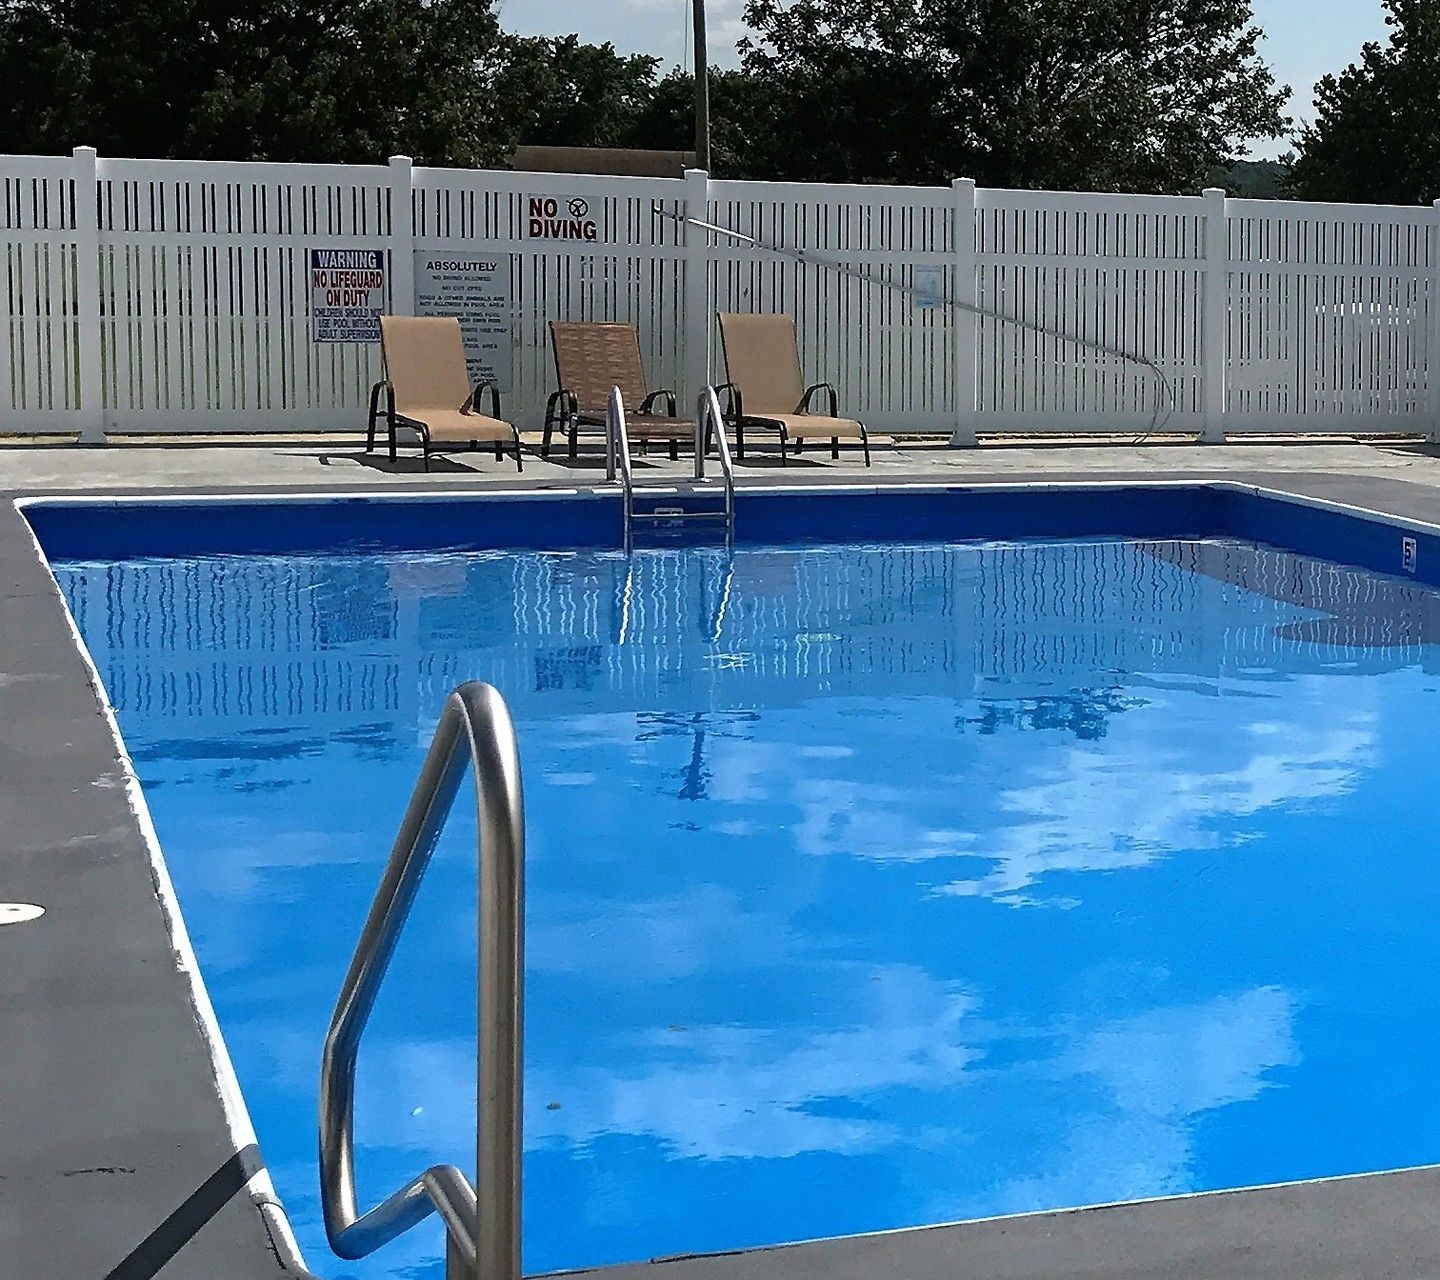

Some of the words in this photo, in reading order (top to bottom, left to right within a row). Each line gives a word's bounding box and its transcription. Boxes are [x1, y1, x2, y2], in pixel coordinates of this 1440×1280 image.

[529, 197, 558, 218] NO
[529, 218, 597, 240] DIVING
[318, 250, 377, 268] WARNING
[426, 261, 498, 272] ABSOLUTELY
[313, 270, 328, 288] NO
[330, 270, 383, 289] LIFEGUARD
[326, 289, 341, 307] ON
[343, 289, 370, 308] DUTY
[314, 308, 343, 317] CHILDREN
[344, 308, 370, 317] SHOULD
[318, 318, 330, 328] USE
[333, 318, 350, 328] POOL
[318, 329, 338, 339] ADULT
